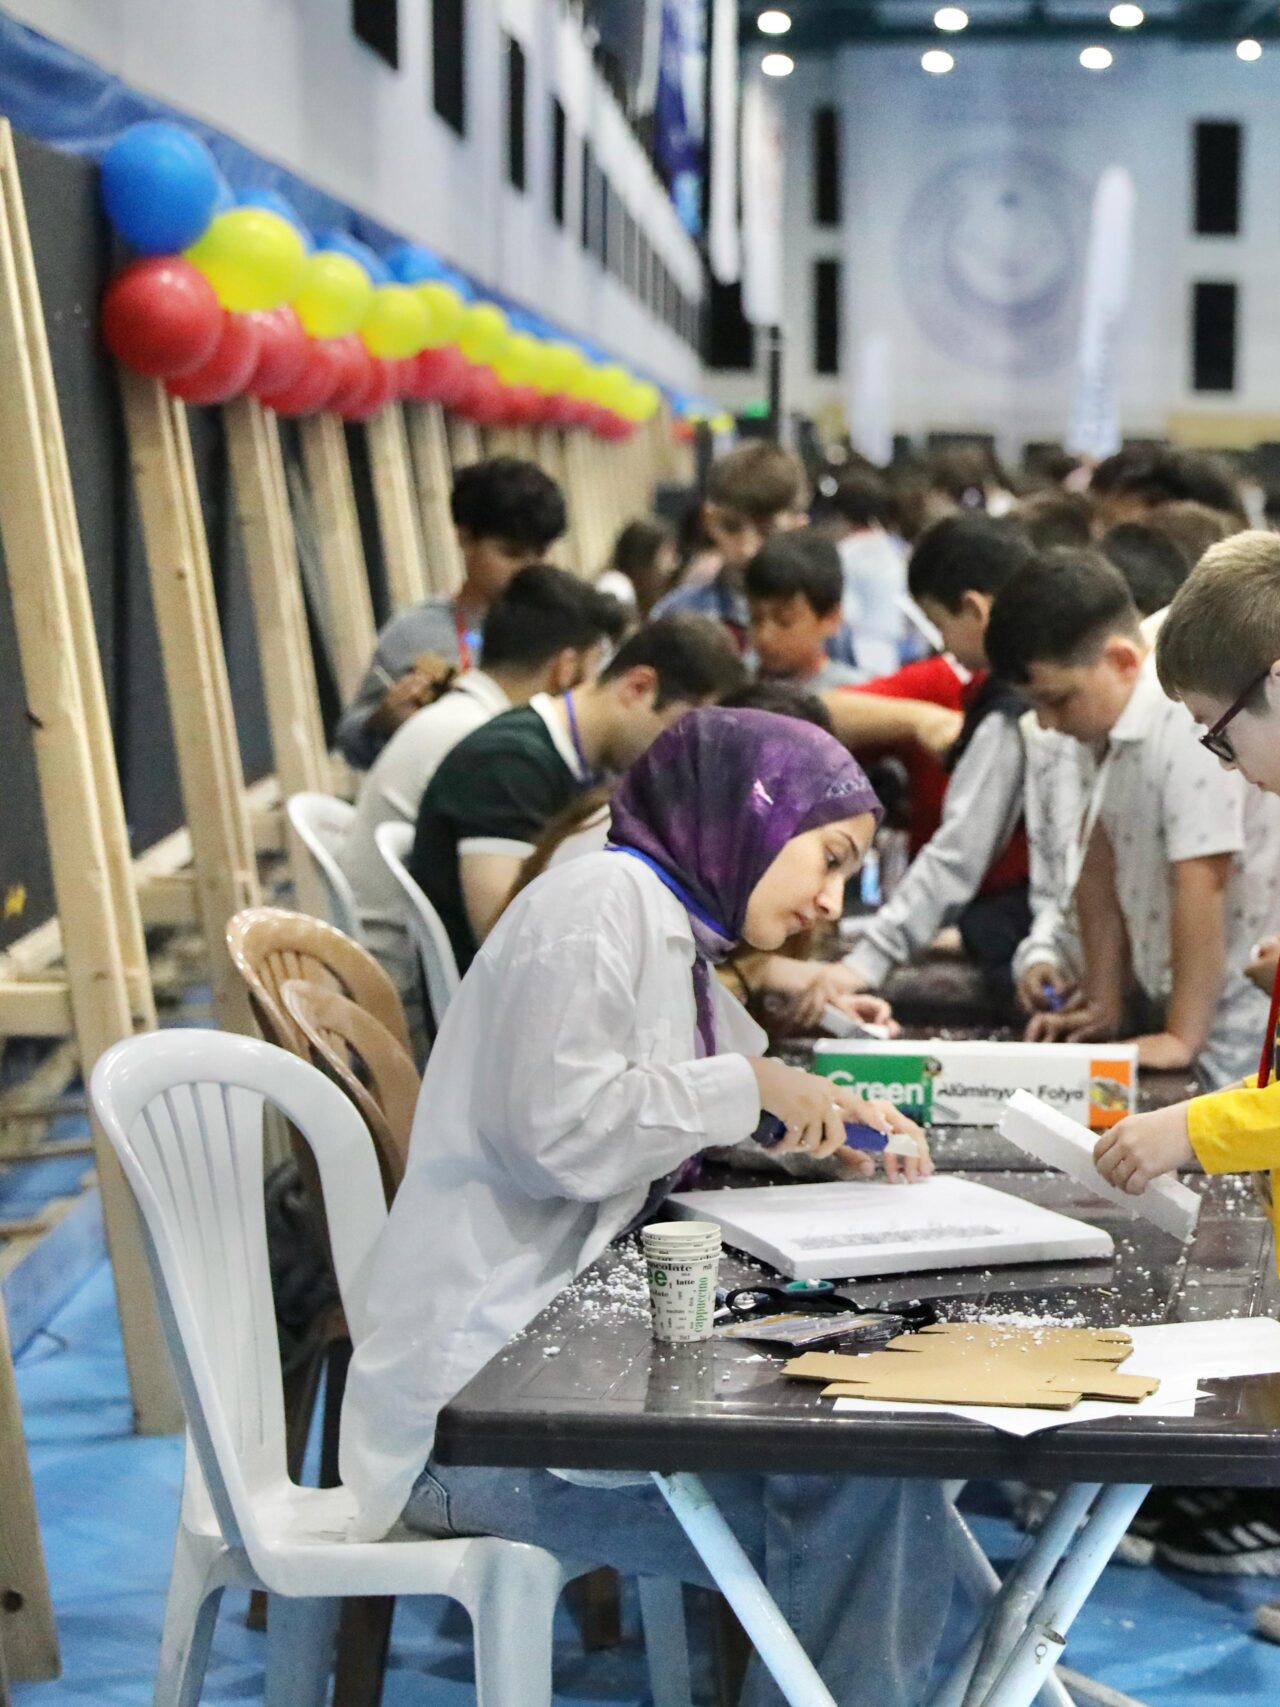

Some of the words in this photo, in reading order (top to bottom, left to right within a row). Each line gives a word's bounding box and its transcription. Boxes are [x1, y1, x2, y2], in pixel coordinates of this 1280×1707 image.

[937, 1082, 1032, 1100] Alüminyu
[1038, 1084, 1084, 1102] Folya
[694, 1277, 708, 1333] cappuccino
